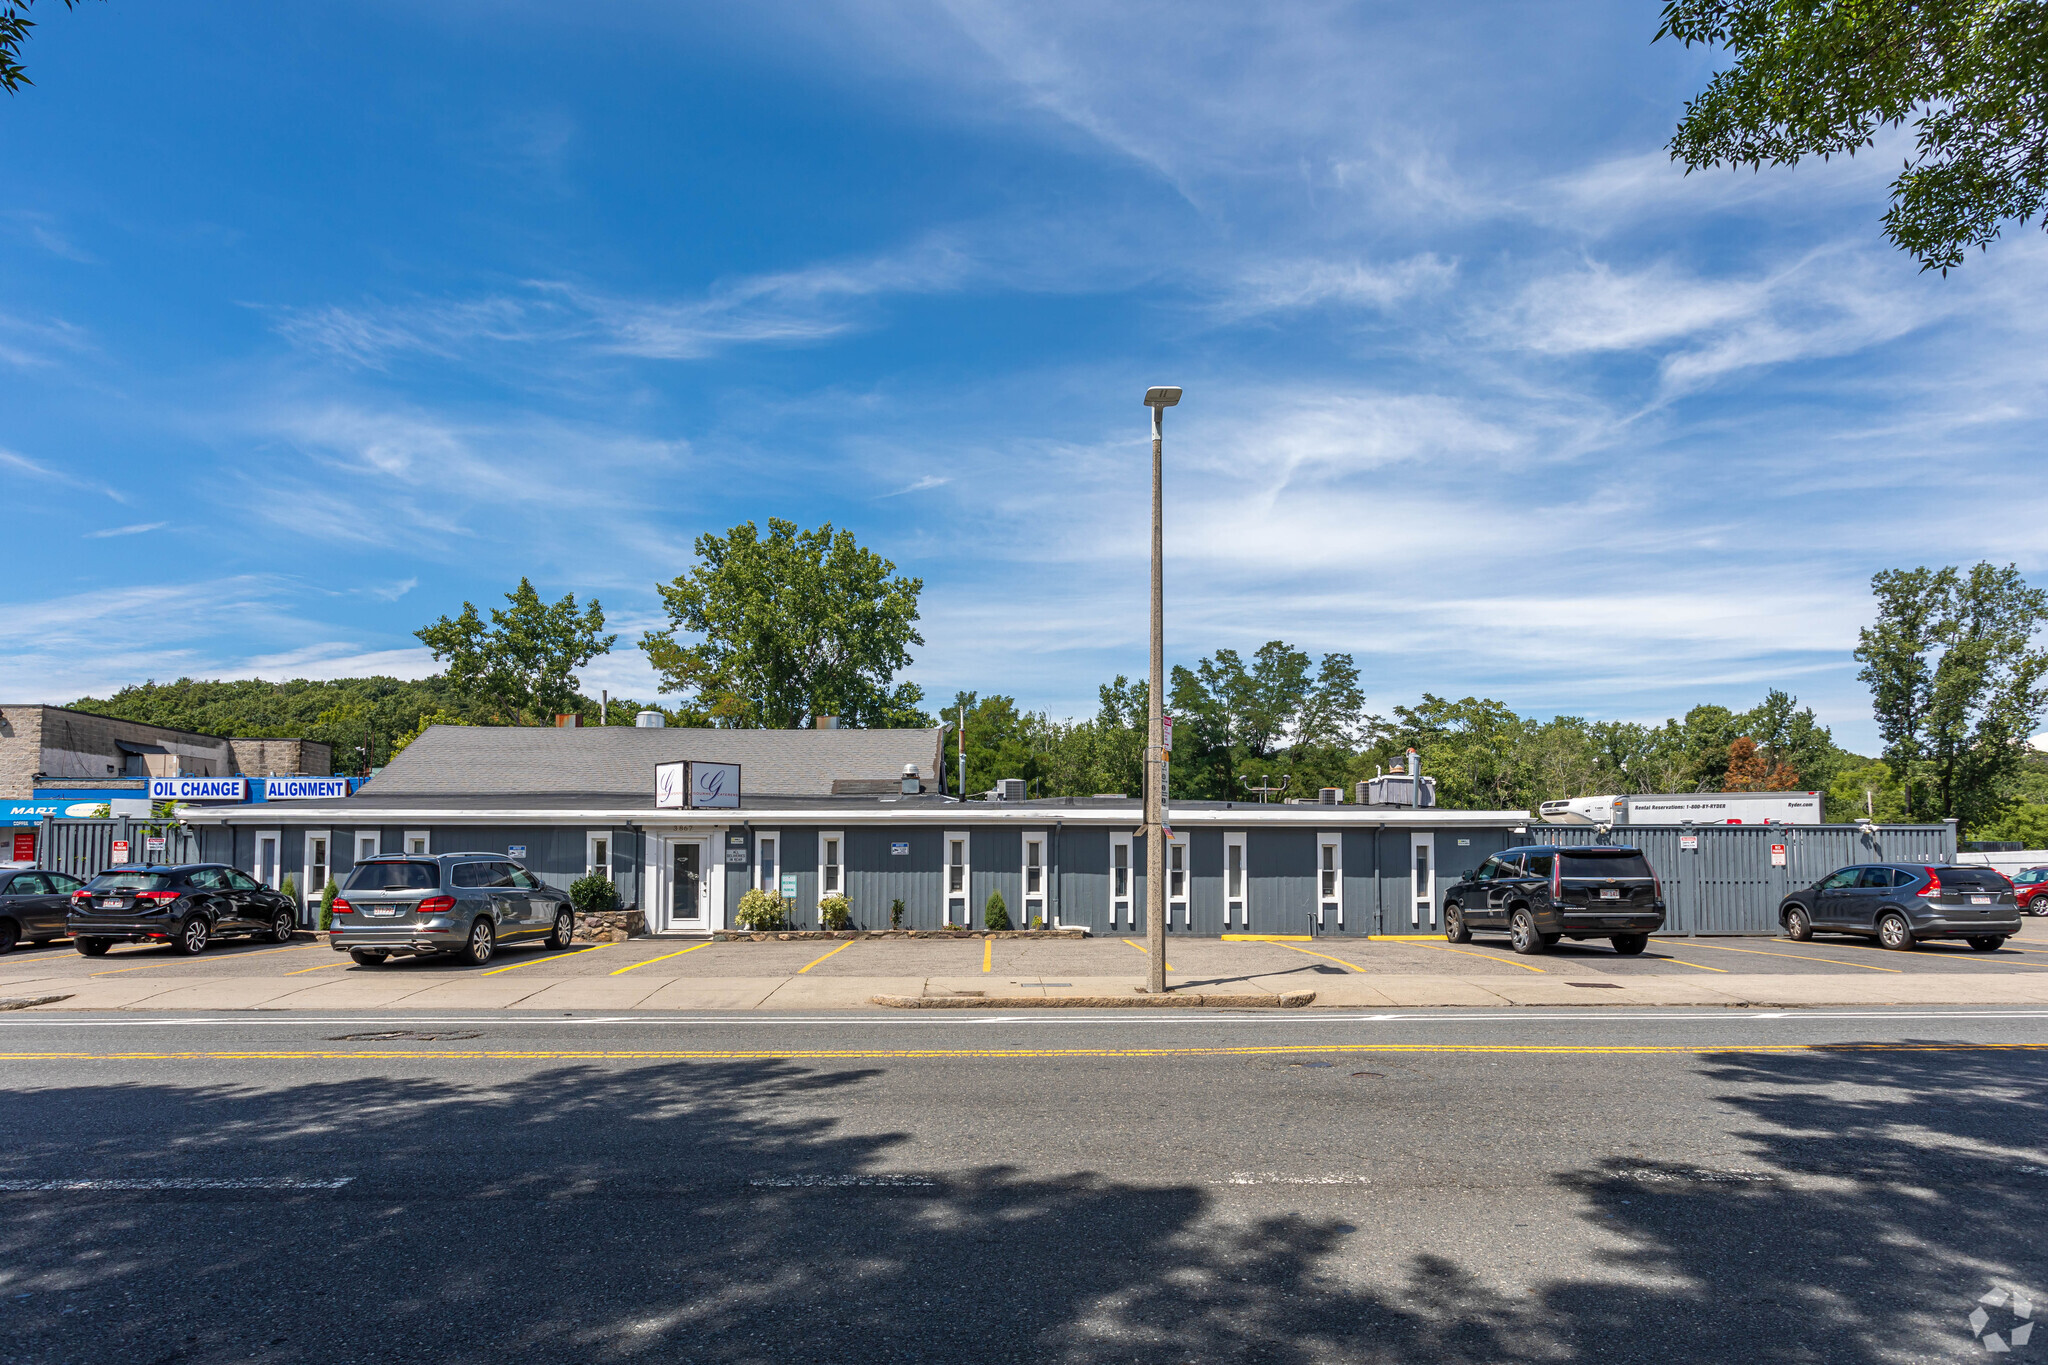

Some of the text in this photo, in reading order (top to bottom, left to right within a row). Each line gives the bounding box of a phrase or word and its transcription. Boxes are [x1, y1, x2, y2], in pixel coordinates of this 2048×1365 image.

[154, 782, 240, 796] OIL CHANGE
[268, 782, 343, 797] ALIGNMENT
[700, 770, 725, 801] G
